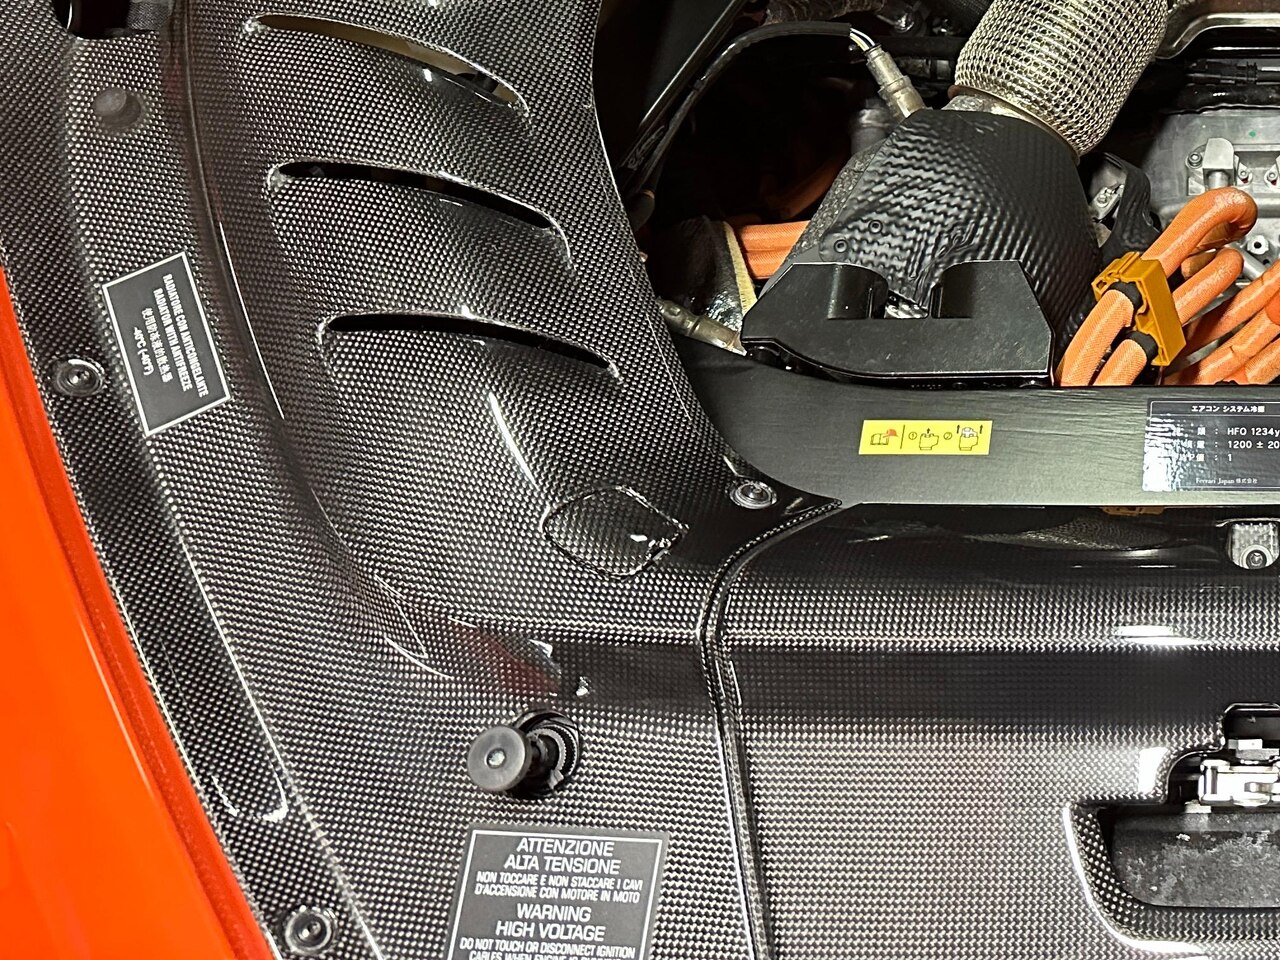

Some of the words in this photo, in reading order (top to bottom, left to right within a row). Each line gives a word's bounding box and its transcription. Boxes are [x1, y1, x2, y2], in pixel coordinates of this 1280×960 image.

[163, 274, 184, 316] RADIATORE
[153, 288, 173, 327] RADIATOR
[175, 314, 188, 332] CON
[165, 324, 179, 346] WITH
[170, 345, 193, 392] ANTIFREEZE
[180, 331, 209, 398] ANTICONGELANTE
[1191, 405, 1220, 413] エアコン
[1227, 427, 1247, 436] HFO
[1228, 440, 1253, 449] 1200
[1227, 453, 1232, 461] 1
[516, 838, 615, 856] ATTENZIONE
[504, 854, 539, 871] ALTA
[544, 857, 621, 875] TENSIONE
[476, 871, 497, 883] NON
[500, 872, 539, 885] TOCCARE
[548, 875, 569, 887] NON
[570, 876, 615, 889] STACCARE
[622, 879, 643, 890] CAVI
[475, 883, 538, 897] D'ACCENSIONE
[539, 887, 559, 899] CON
[561, 888, 599, 901] MOTORE
[600, 890, 611, 902] IN
[612, 891, 640, 903] MOTO
[517, 903, 592, 922] WARNING
[496, 921, 535, 938] HIGH
[539, 923, 606, 942] VOLTAGE
[460, 937, 474, 950] DO
[475, 938, 494, 950] NOT
[495, 939, 524, 952] TOUCH
[525, 941, 539, 953] OR
[540, 942, 595, 956] DISCONNECT
[596, 945, 636, 959] IGNITION
